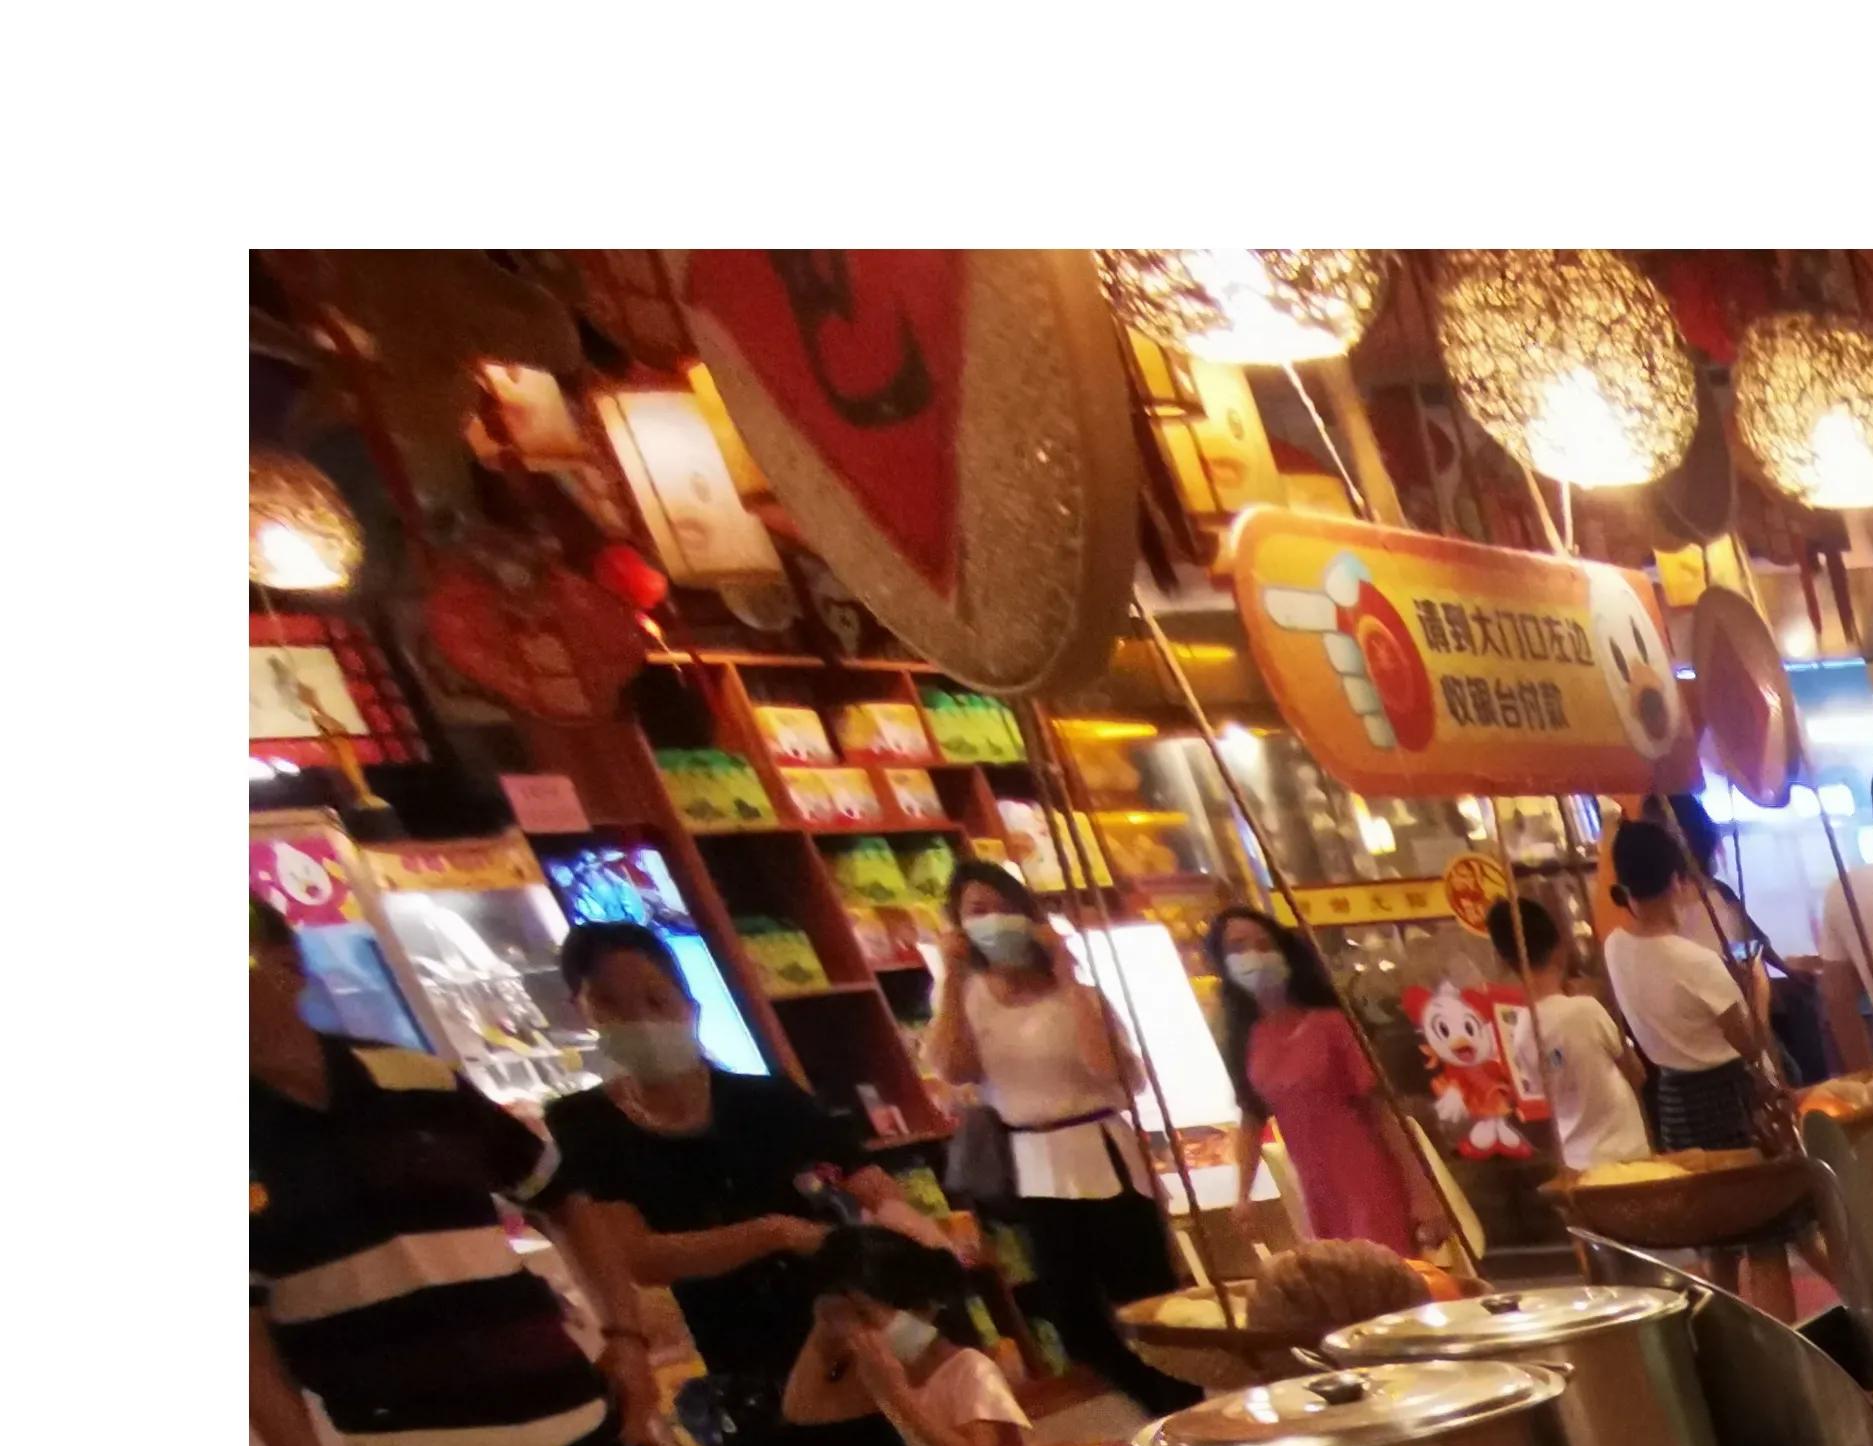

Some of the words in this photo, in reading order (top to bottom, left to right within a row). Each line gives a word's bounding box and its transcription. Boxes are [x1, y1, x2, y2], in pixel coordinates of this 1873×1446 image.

[1413, 598, 1595, 667] 请到大门口左边
[1440, 675, 1570, 731] 收银台付款
